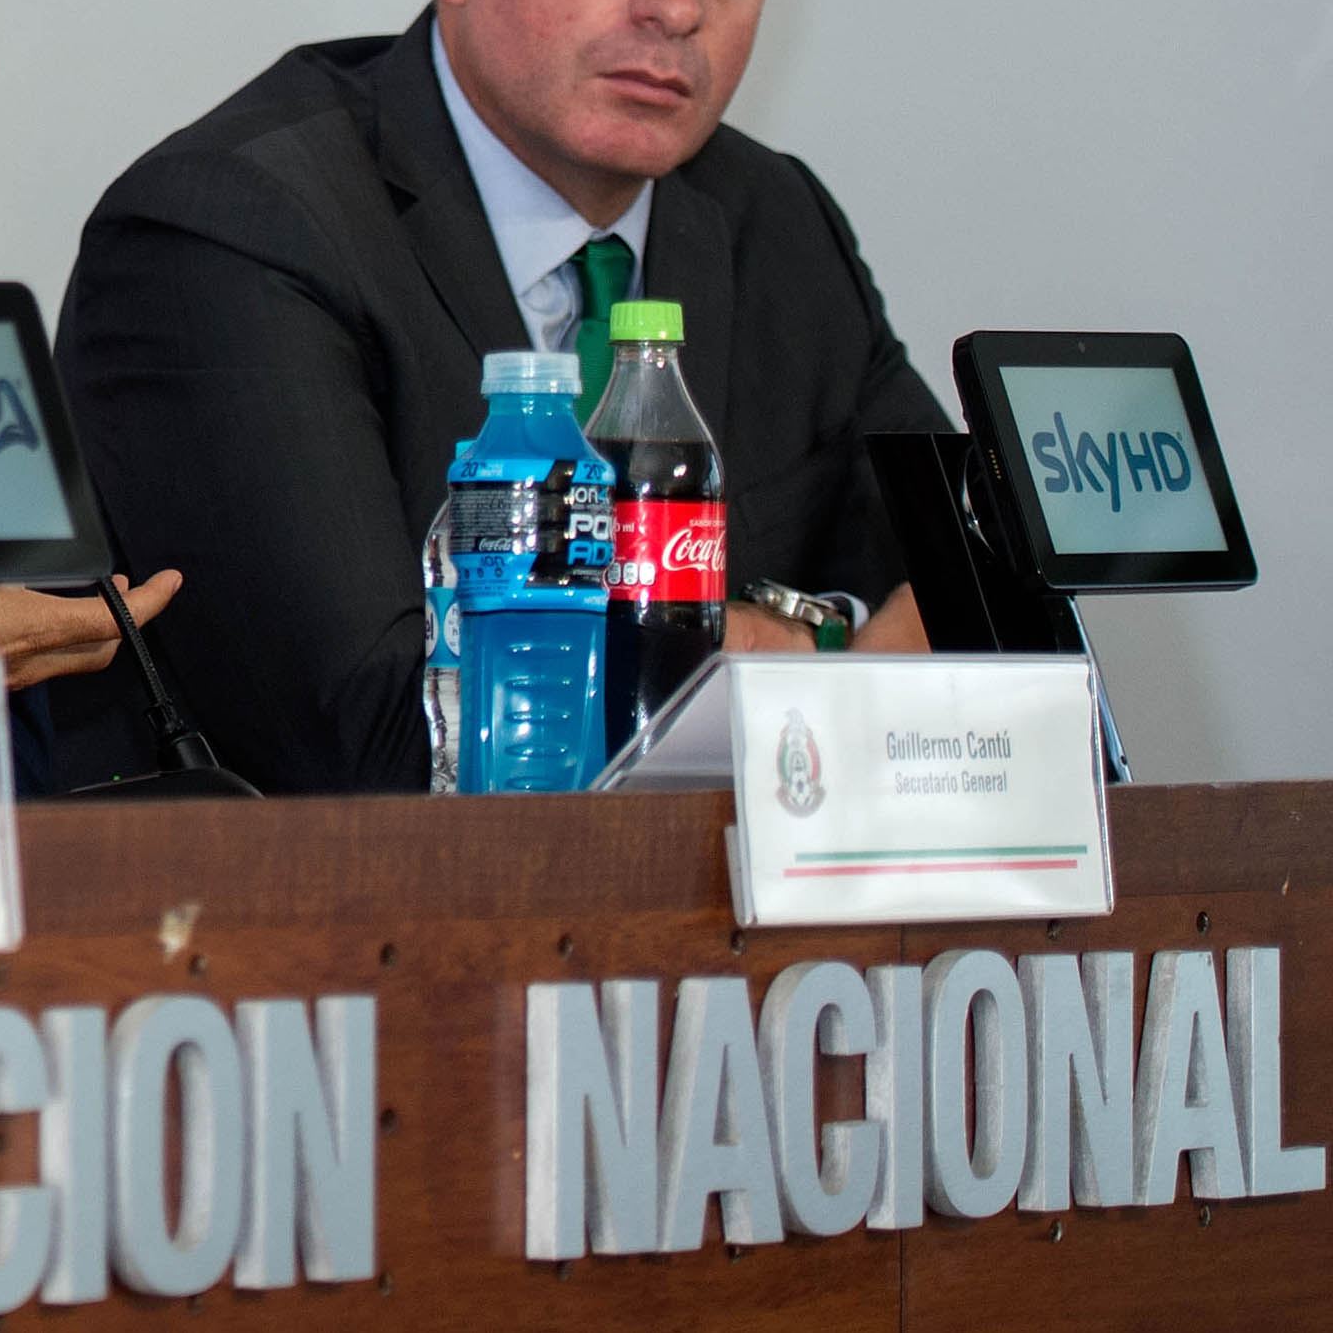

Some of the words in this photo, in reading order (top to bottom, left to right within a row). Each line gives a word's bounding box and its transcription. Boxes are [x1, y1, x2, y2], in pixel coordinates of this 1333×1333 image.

[886, 731, 963, 761] Guillermo
[966, 730, 1011, 759] Cantú
[895, 771, 959, 795] Secretario
[961, 770, 1008, 794] General
[525, 948, 1327, 1261] NACIONAL
